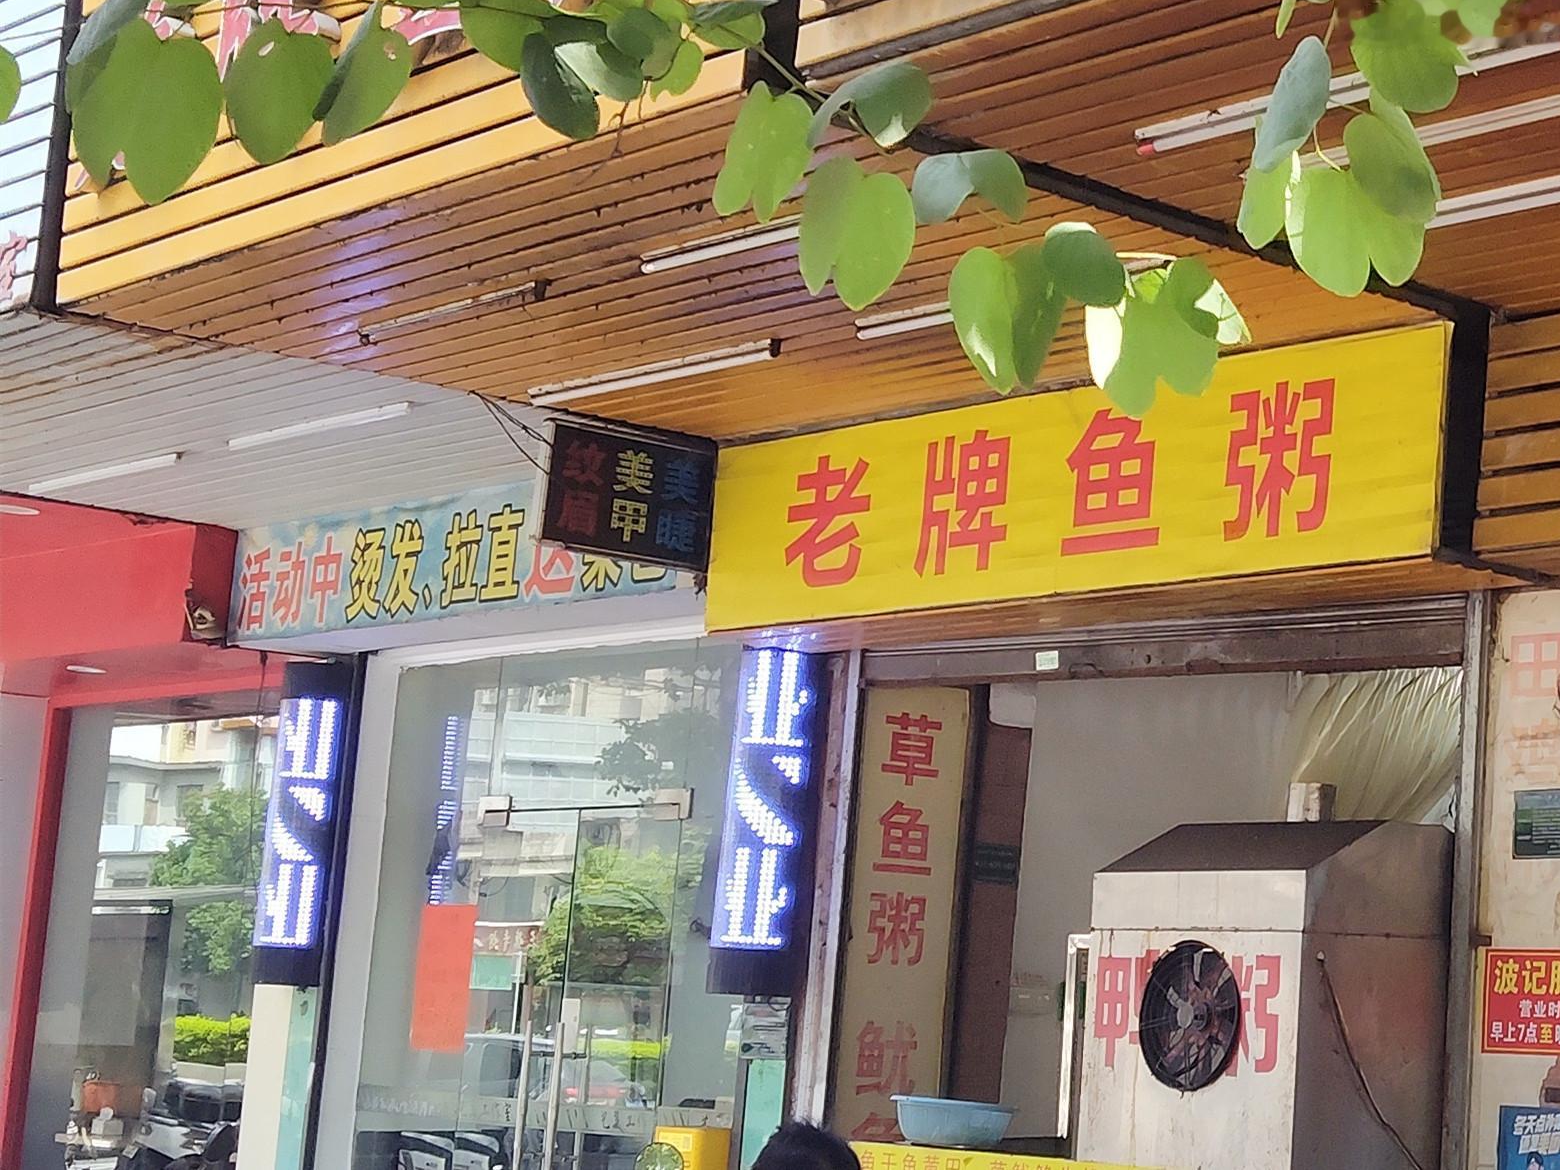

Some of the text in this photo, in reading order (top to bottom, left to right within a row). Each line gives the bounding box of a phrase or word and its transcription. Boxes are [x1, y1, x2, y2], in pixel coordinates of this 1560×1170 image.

[610, 447, 656, 544] 美甲
[784, 377, 1337, 589] 老牌鱼粥
[867, 712, 943, 969] 草鱼粥
